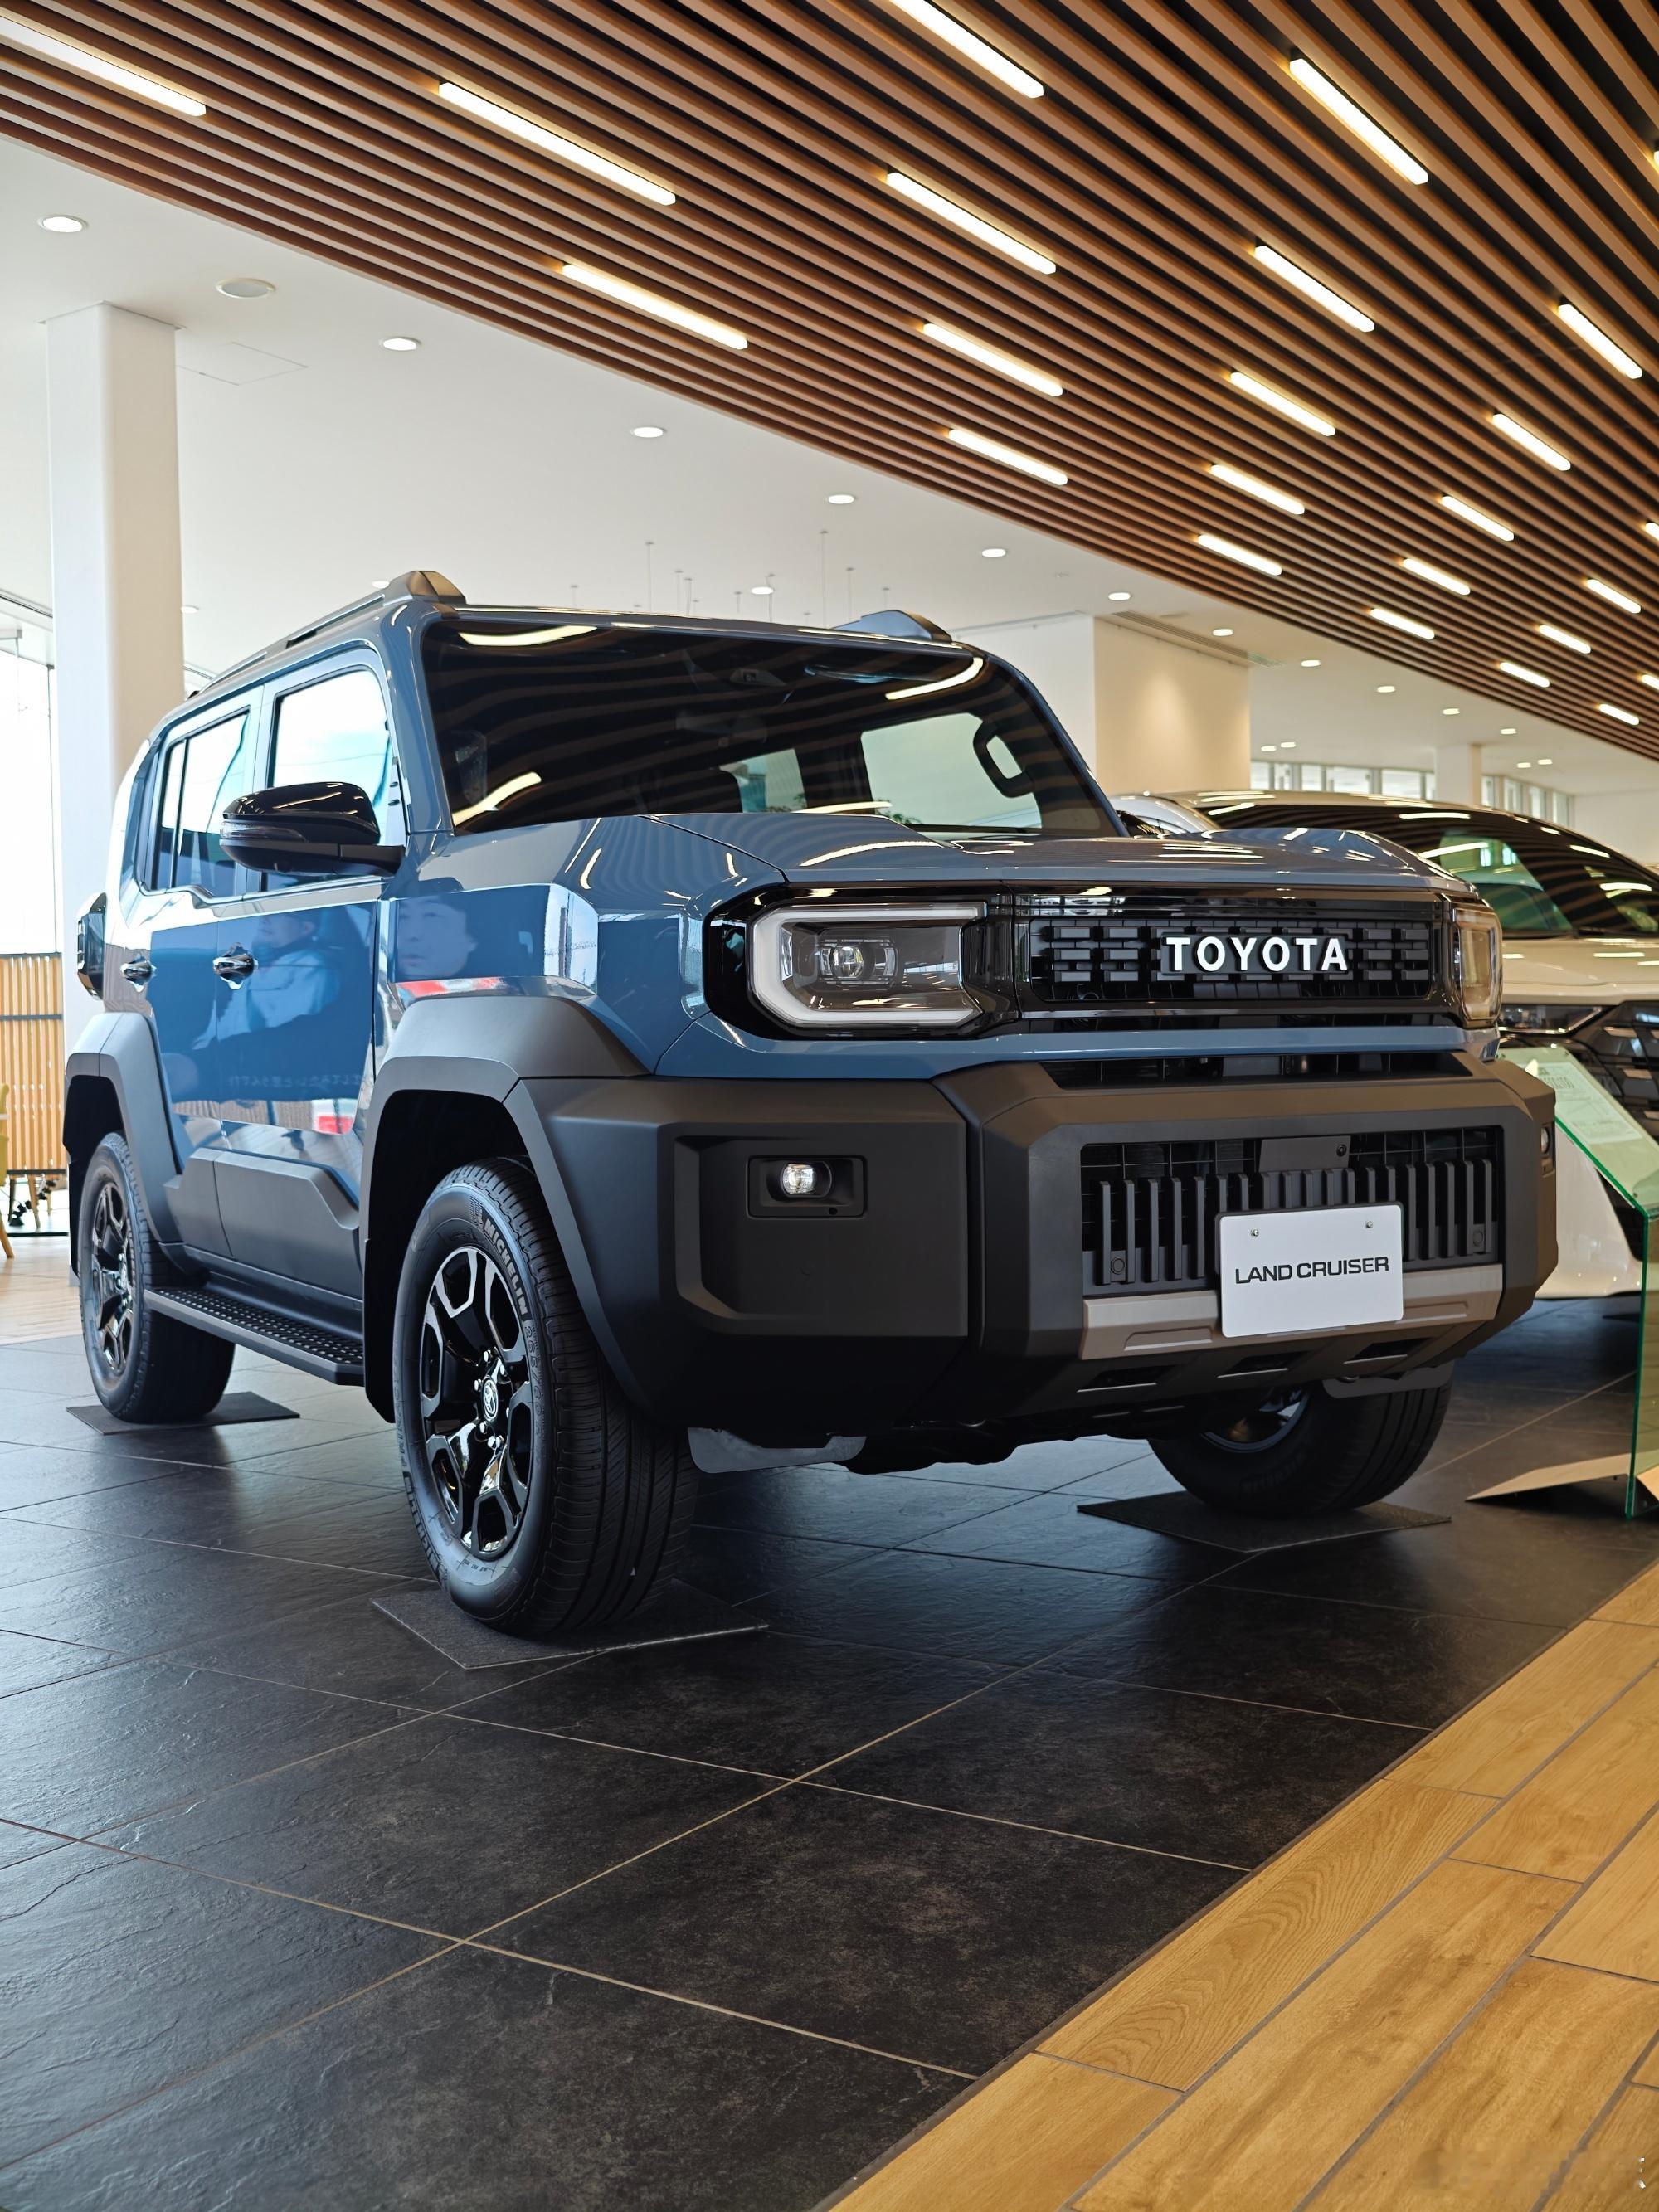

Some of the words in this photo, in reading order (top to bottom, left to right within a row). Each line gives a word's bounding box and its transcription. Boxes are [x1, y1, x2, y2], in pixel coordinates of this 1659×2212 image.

[1165, 936, 1348, 972] TOYOTA
[484, 1218, 529, 1315] MICHELIN
[1235, 1264, 1292, 1285] LAND
[1297, 1256, 1389, 1279] CRUISER
